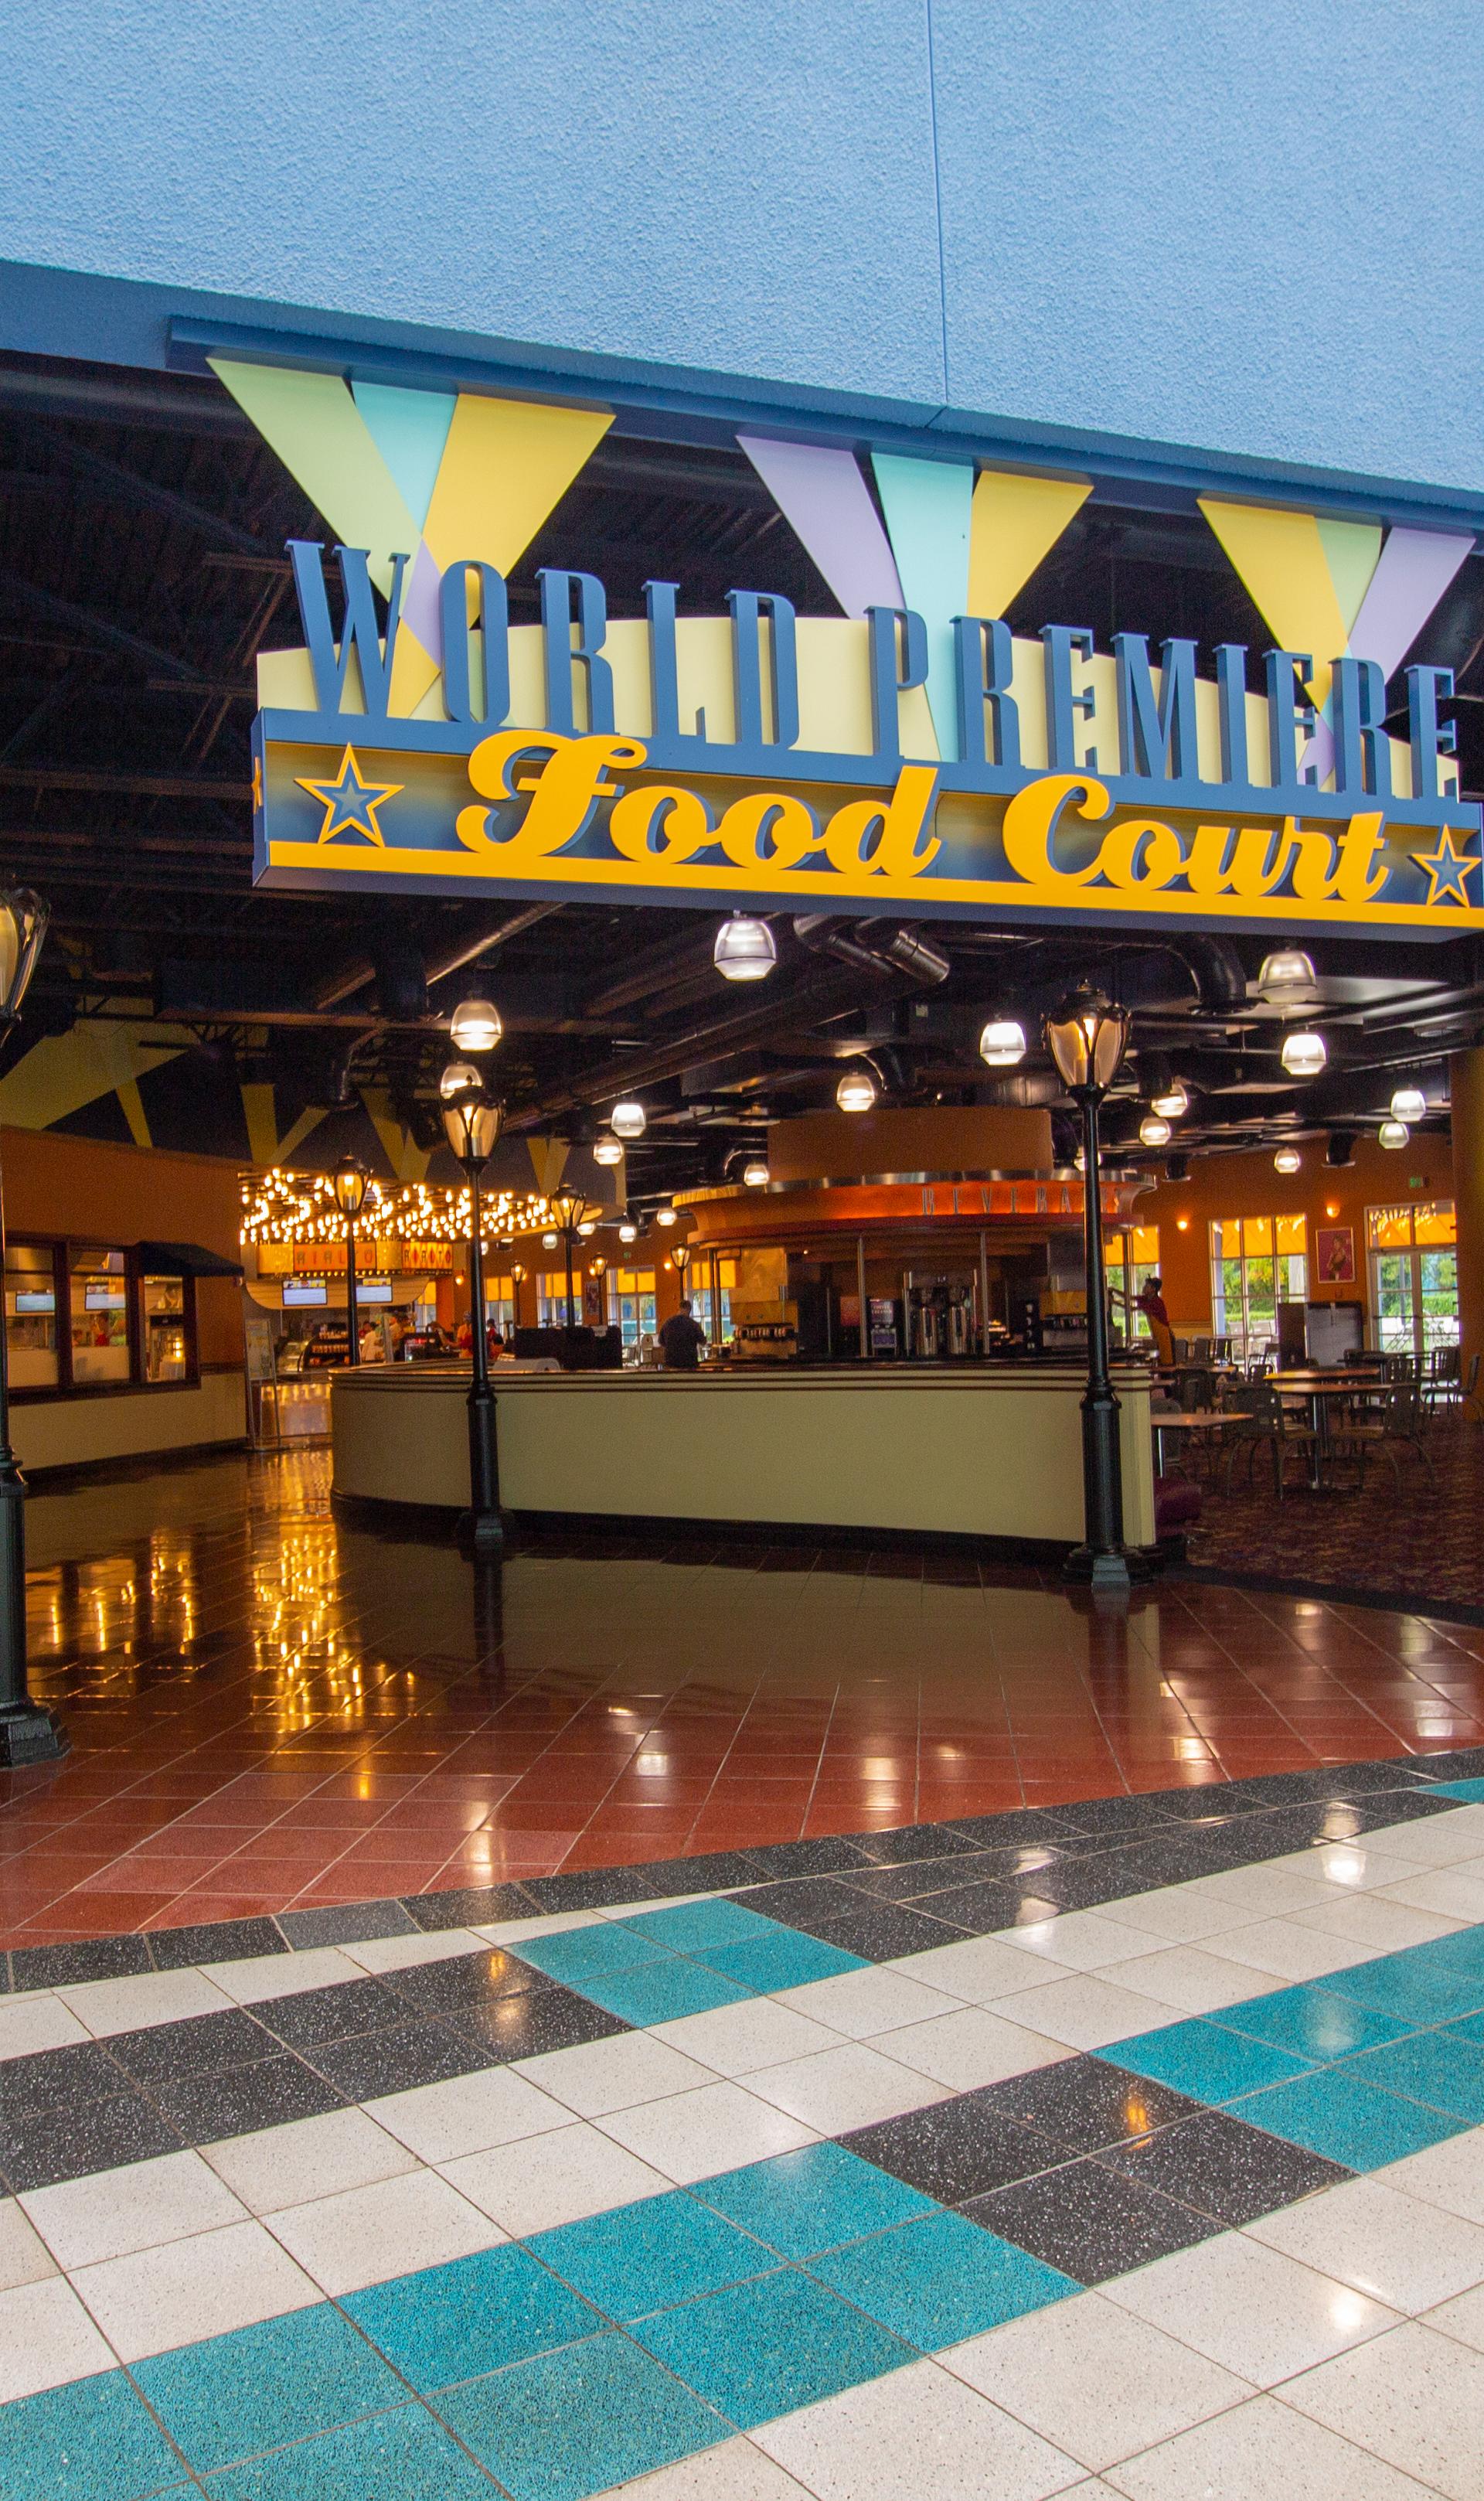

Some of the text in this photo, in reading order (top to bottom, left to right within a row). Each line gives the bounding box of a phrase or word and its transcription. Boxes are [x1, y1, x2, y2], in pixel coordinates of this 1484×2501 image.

[284, 539, 1458, 802] WORLD PREMIERE
[456, 729, 1391, 902] Food Court
[922, 1187, 1122, 1215] BEVERAES
[297, 1249, 373, 1265] RIALO
[404, 1248, 451, 1263] RIALTO
